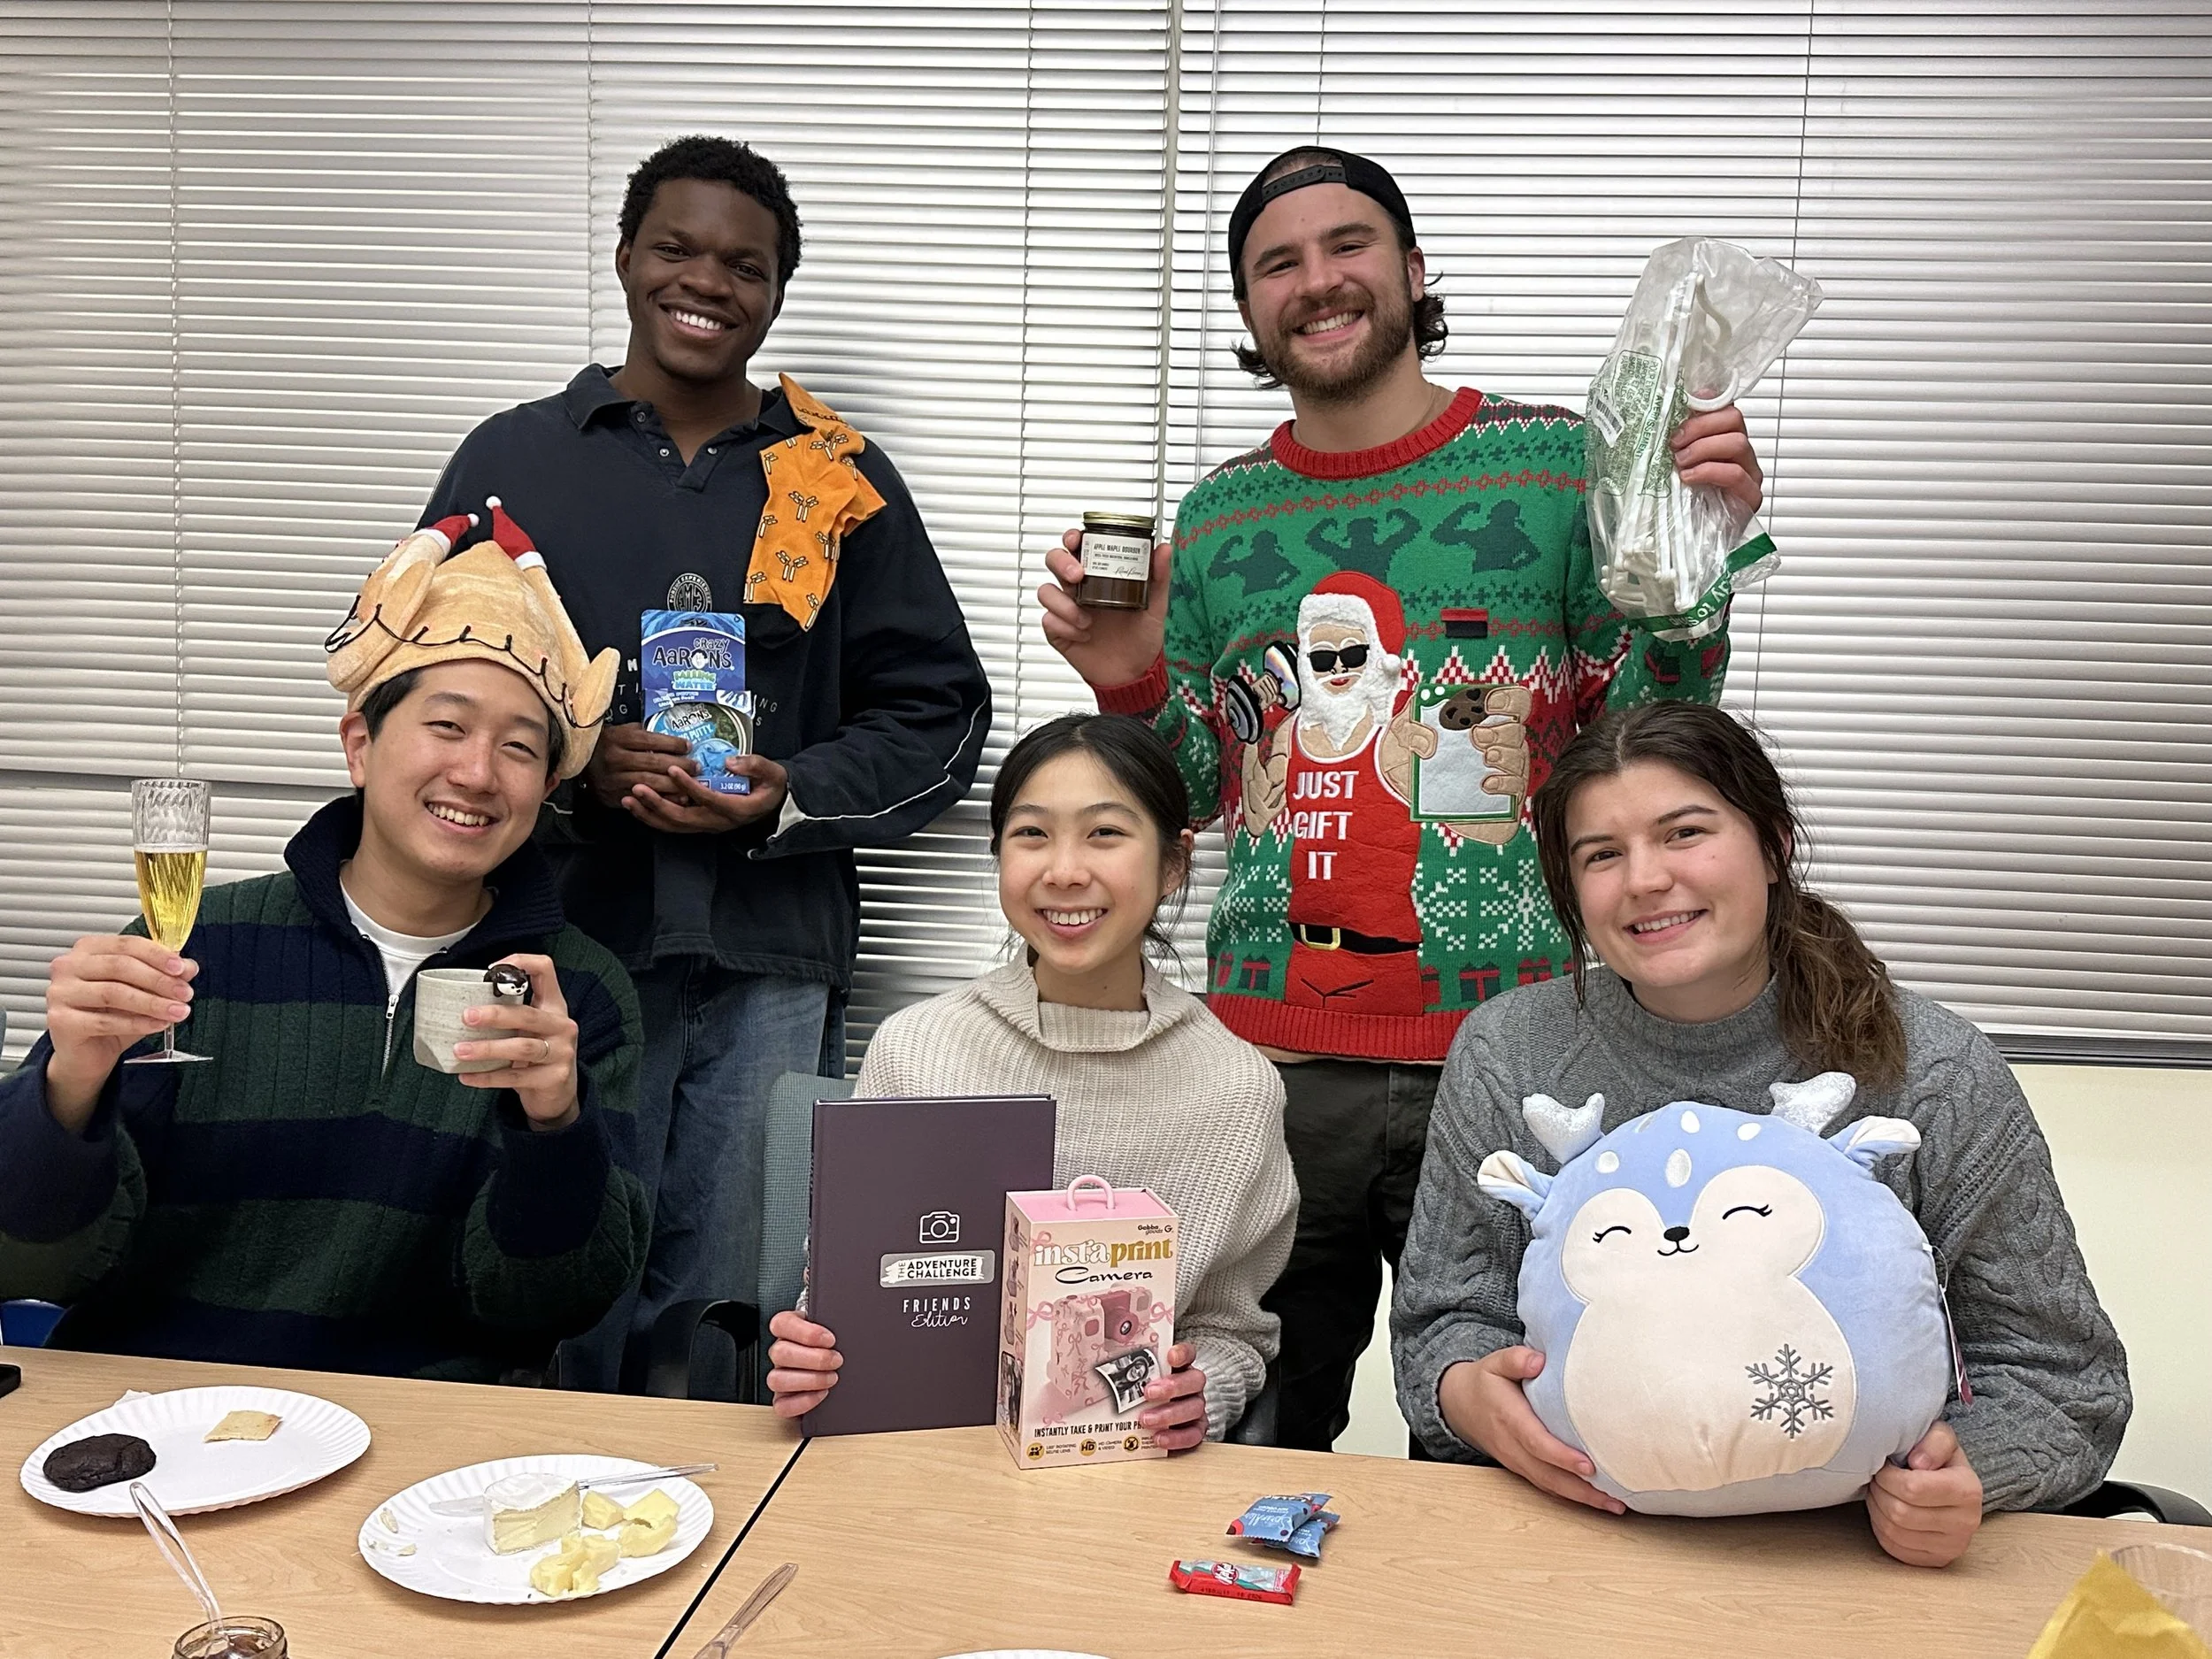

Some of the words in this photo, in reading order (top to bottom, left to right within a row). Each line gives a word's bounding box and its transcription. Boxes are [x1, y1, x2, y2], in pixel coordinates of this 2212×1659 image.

[1697, 602, 1716, 618] to
[674, 680, 715, 690] WATER
[1293, 771, 1360, 800] JUST
[1293, 811, 1354, 841] GIFT
[1308, 851, 1338, 880] IT
[907, 1258, 977, 1270] ADVENTURE
[907, 1268, 977, 1279] CHALLENGE
[1055, 1266, 1153, 1284] Camera
[902, 1296, 971, 1313] FRIENDS
[910, 1310, 969, 1327] Edition
[1034, 1426, 1069, 1438] INSTANTLY
[1071, 1425, 1086, 1434] TAKE
[1094, 1423, 1113, 1433] PRINT
[1115, 1421, 1132, 1431] YOUR
[1080, 1441, 1096, 1451] HD
